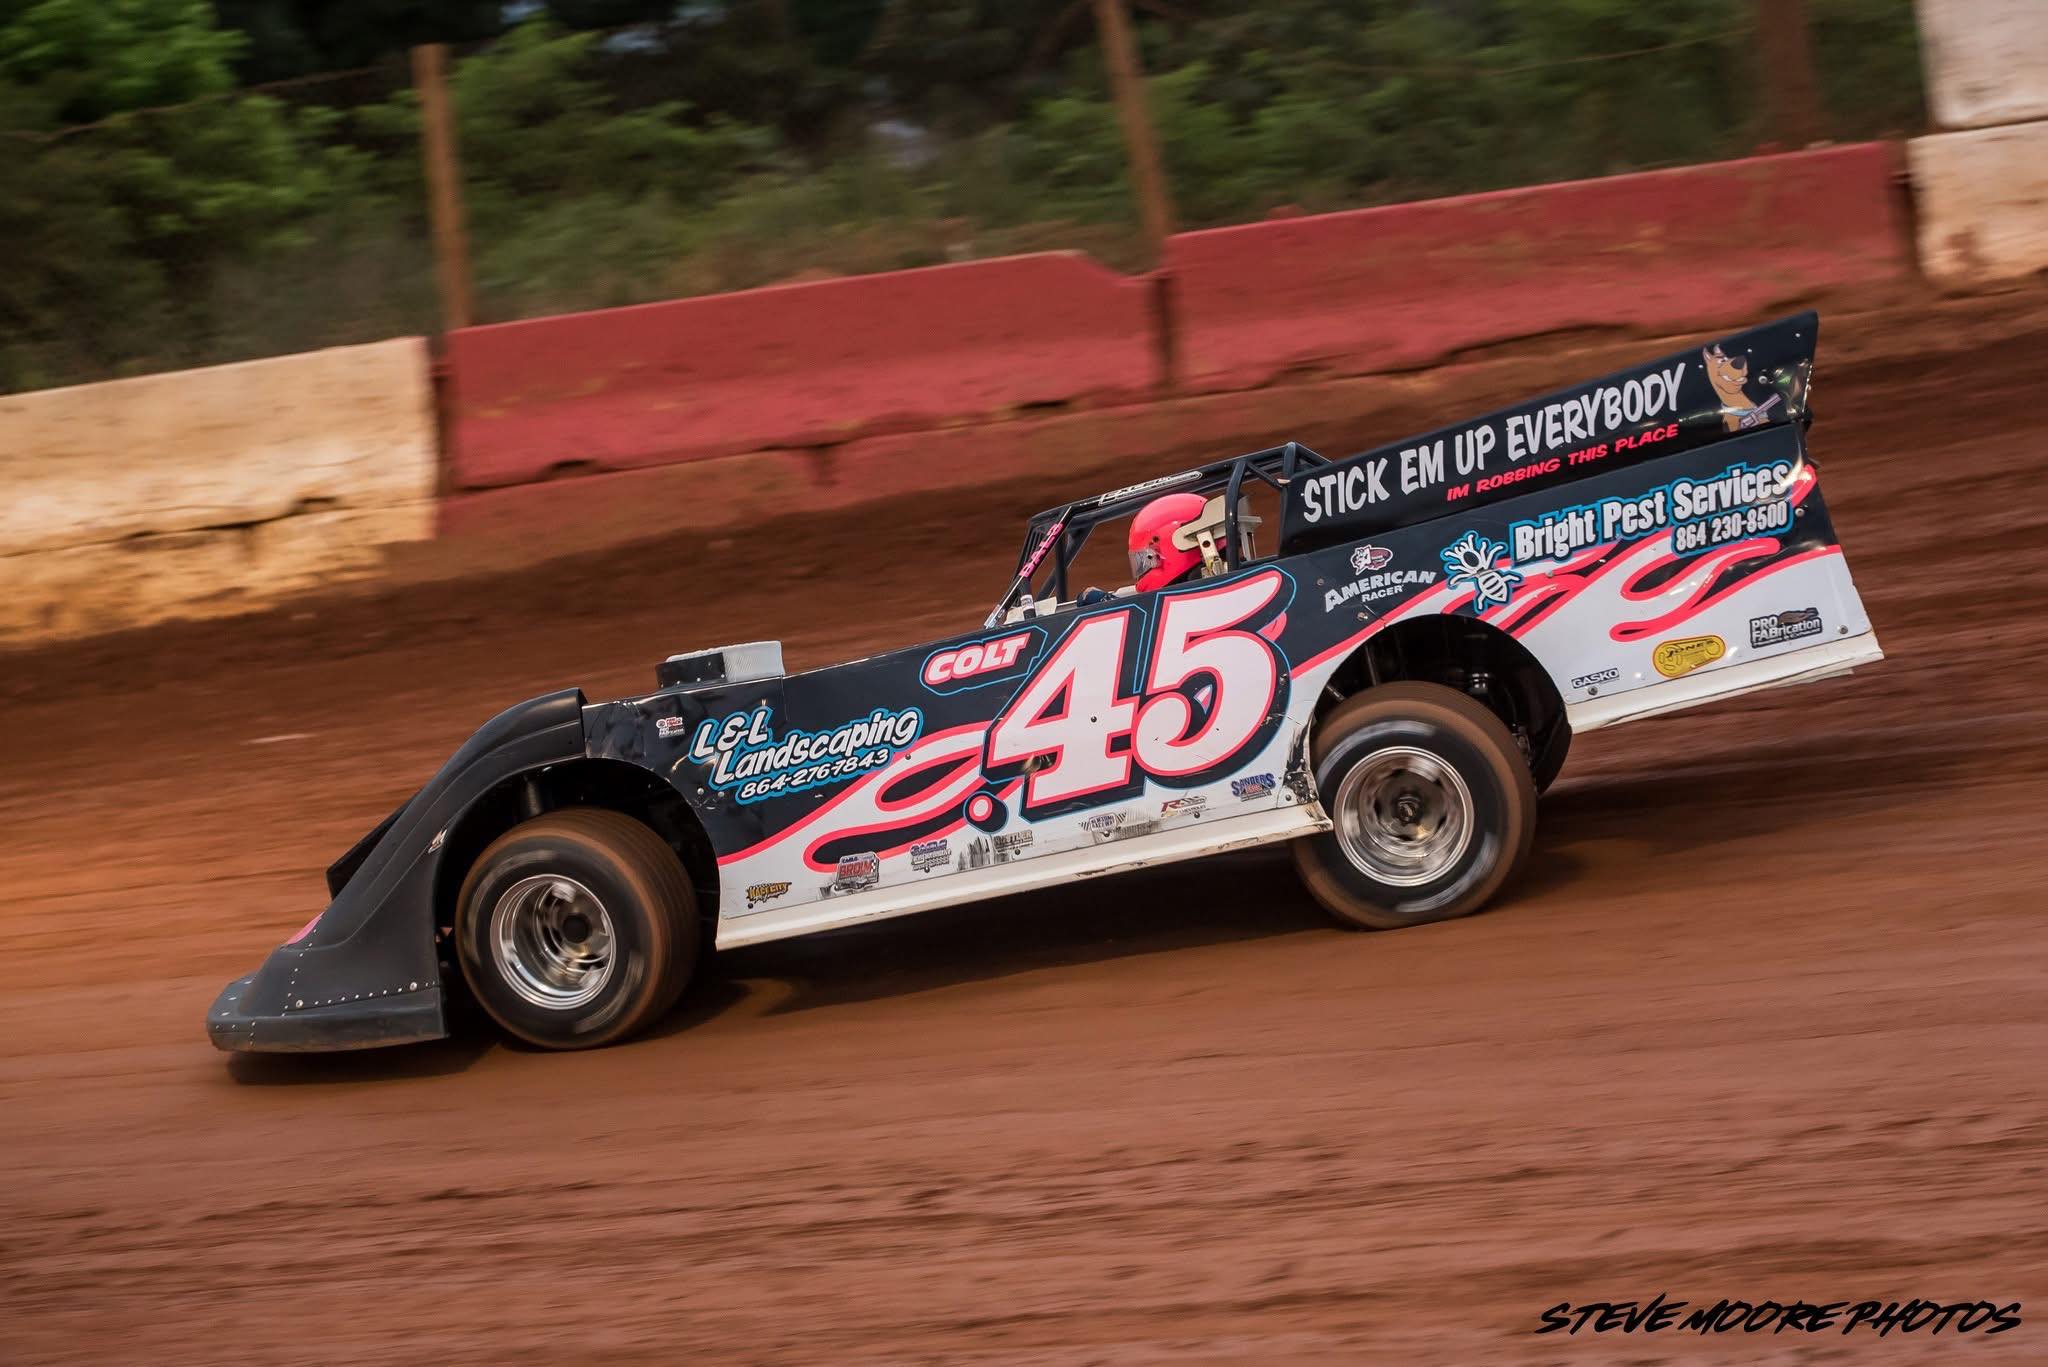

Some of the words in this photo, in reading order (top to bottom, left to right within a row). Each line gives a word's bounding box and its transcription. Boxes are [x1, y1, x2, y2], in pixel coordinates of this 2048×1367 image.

[1303, 457, 1391, 523] STICK
[1400, 440, 1445, 496] EM
[1455, 424, 1496, 475] UP
[1506, 362, 1687, 462] EVERYBODY
[1447, 483, 1471, 501] IM
[1476, 458, 1561, 493] ROBBING
[1568, 444, 1608, 466] THIS
[1615, 423, 1679, 453] PLACE
[1515, 508, 1596, 563] Bright
[1602, 490, 1666, 539] Pest
[1673, 463, 1789, 521] Services
[1676, 520, 1707, 552] 864
[1711, 499, 1788, 544] 230-8500
[1324, 570, 1437, 614] AMERICAN
[1361, 585, 1404, 603] RACER
[1751, 616, 1778, 632] PRO
[1752, 618, 1820, 643] FABrication
[925, 632, 1032, 686] COLT
[1572, 669, 1619, 688] GASKO
[694, 710, 768, 757] L&L
[715, 710, 919, 784] Landscaping
[1231, 772, 1276, 797] SANDERS
